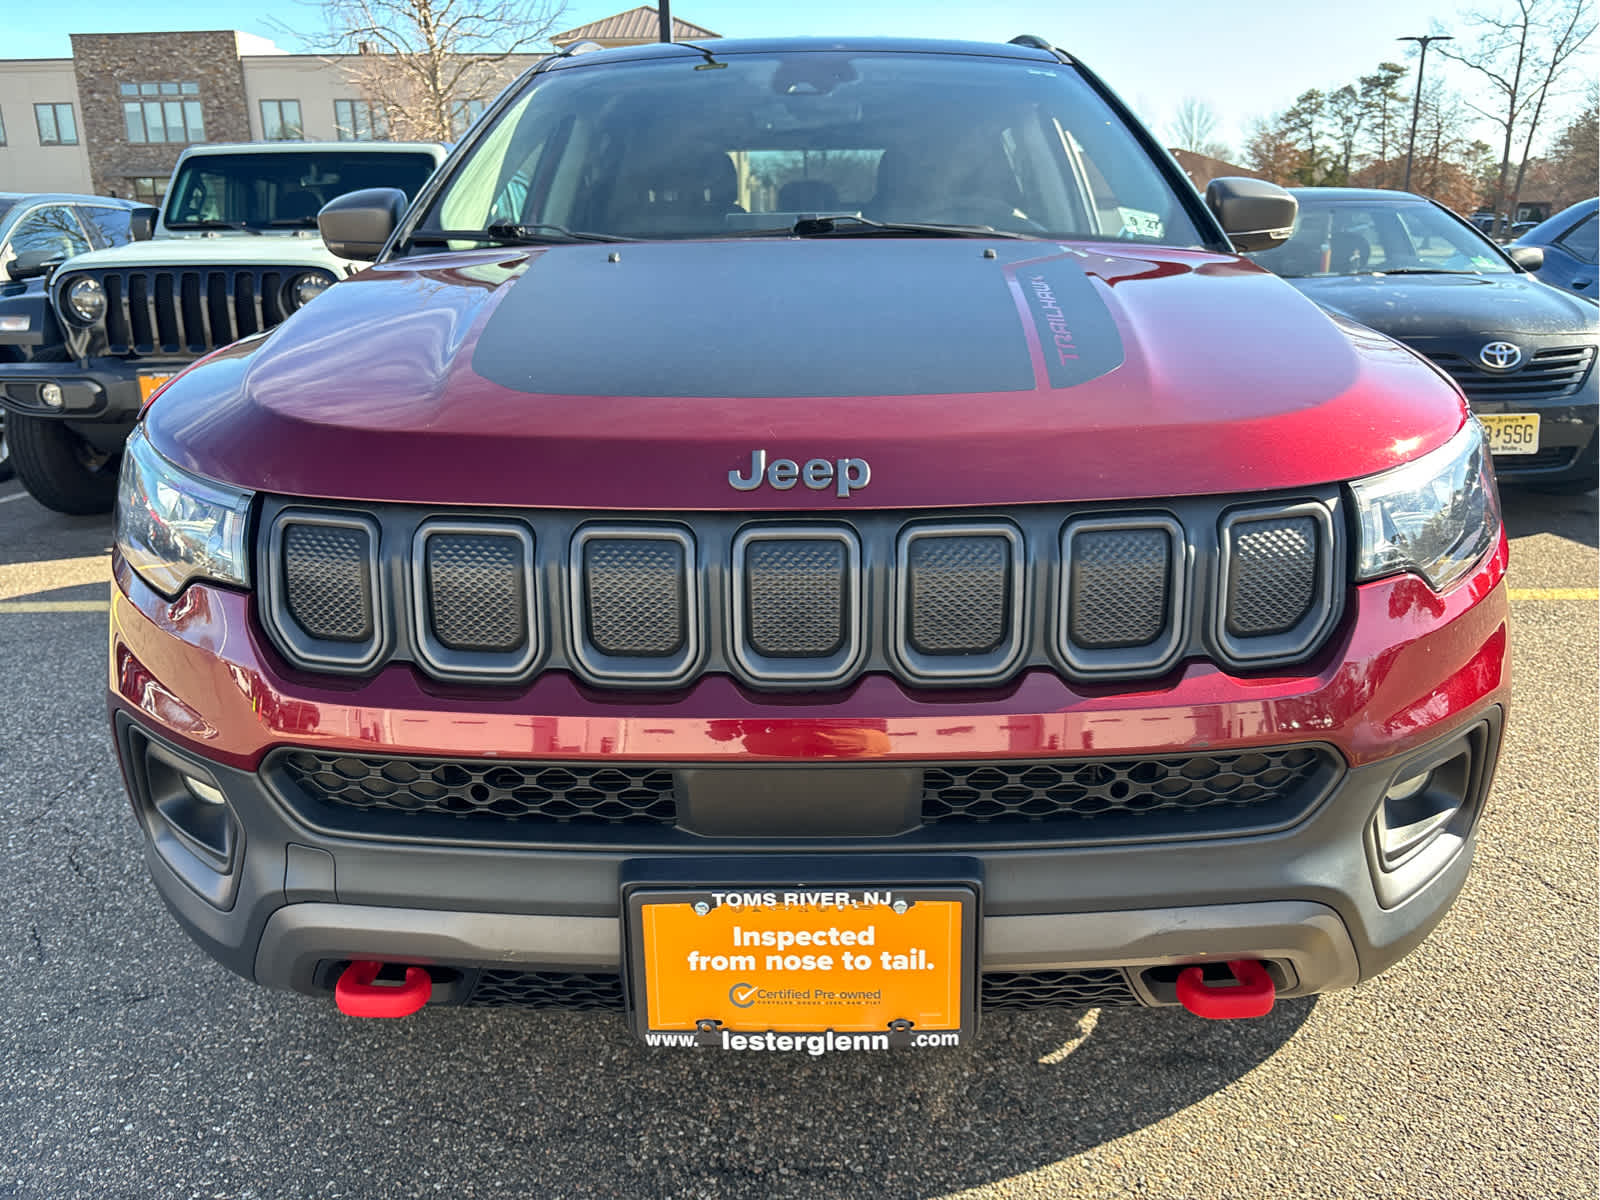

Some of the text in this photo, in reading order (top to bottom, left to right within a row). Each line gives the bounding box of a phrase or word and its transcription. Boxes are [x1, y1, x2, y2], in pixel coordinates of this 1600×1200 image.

[1028, 274, 1079, 366] TRAILHAWK
[728, 449, 871, 498] Jeep
[712, 891, 892, 907] TOMS RIVER, NJ
[733, 926, 875, 951] Inspected
[687, 948, 935, 971] from nose to tail.
[757, 989, 881, 999] Certified Pre-owned
[646, 1030, 959, 1056] www. lesterglenn .com
